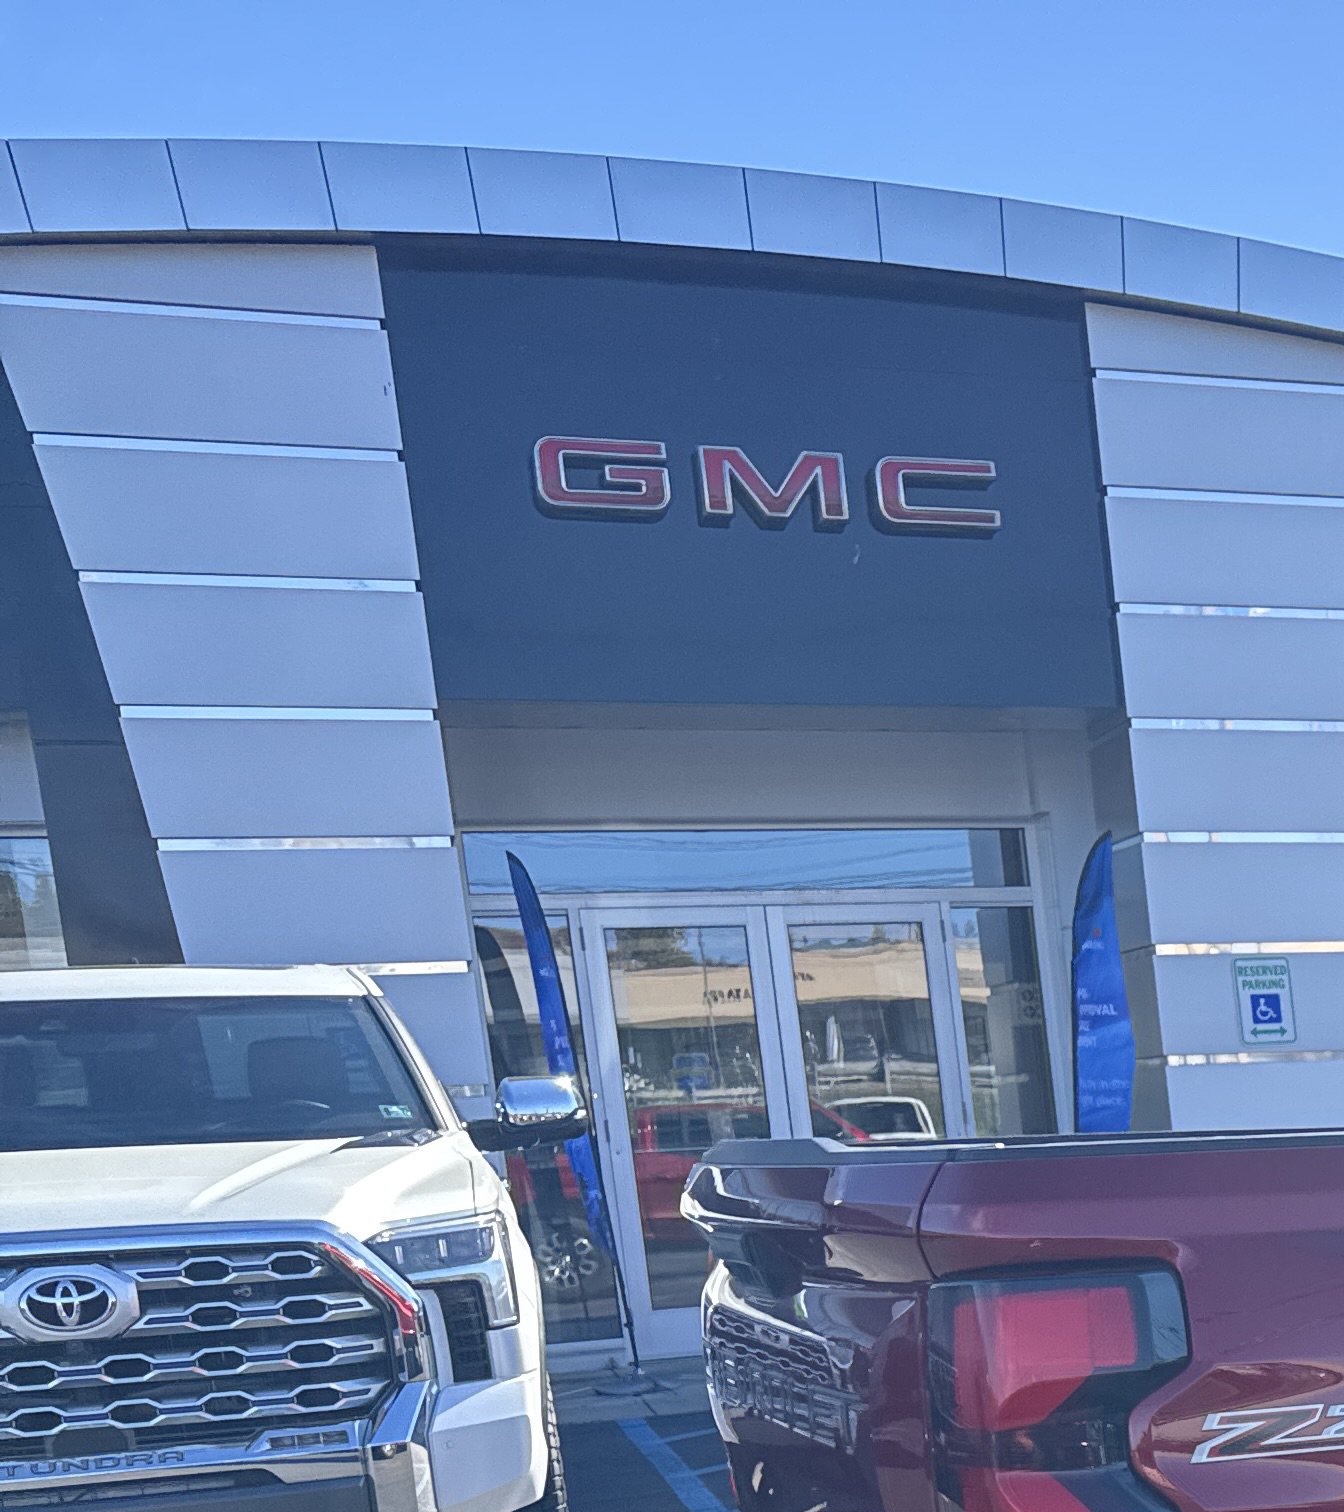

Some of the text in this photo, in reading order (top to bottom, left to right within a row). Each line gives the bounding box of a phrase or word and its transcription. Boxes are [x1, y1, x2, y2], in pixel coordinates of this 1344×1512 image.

[533, 435, 1001, 532] GMC
[1236, 964, 1288, 977] RESERVED
[1241, 978, 1286, 991] PARKING
[0, 1450, 184, 1477] TUNDRA
